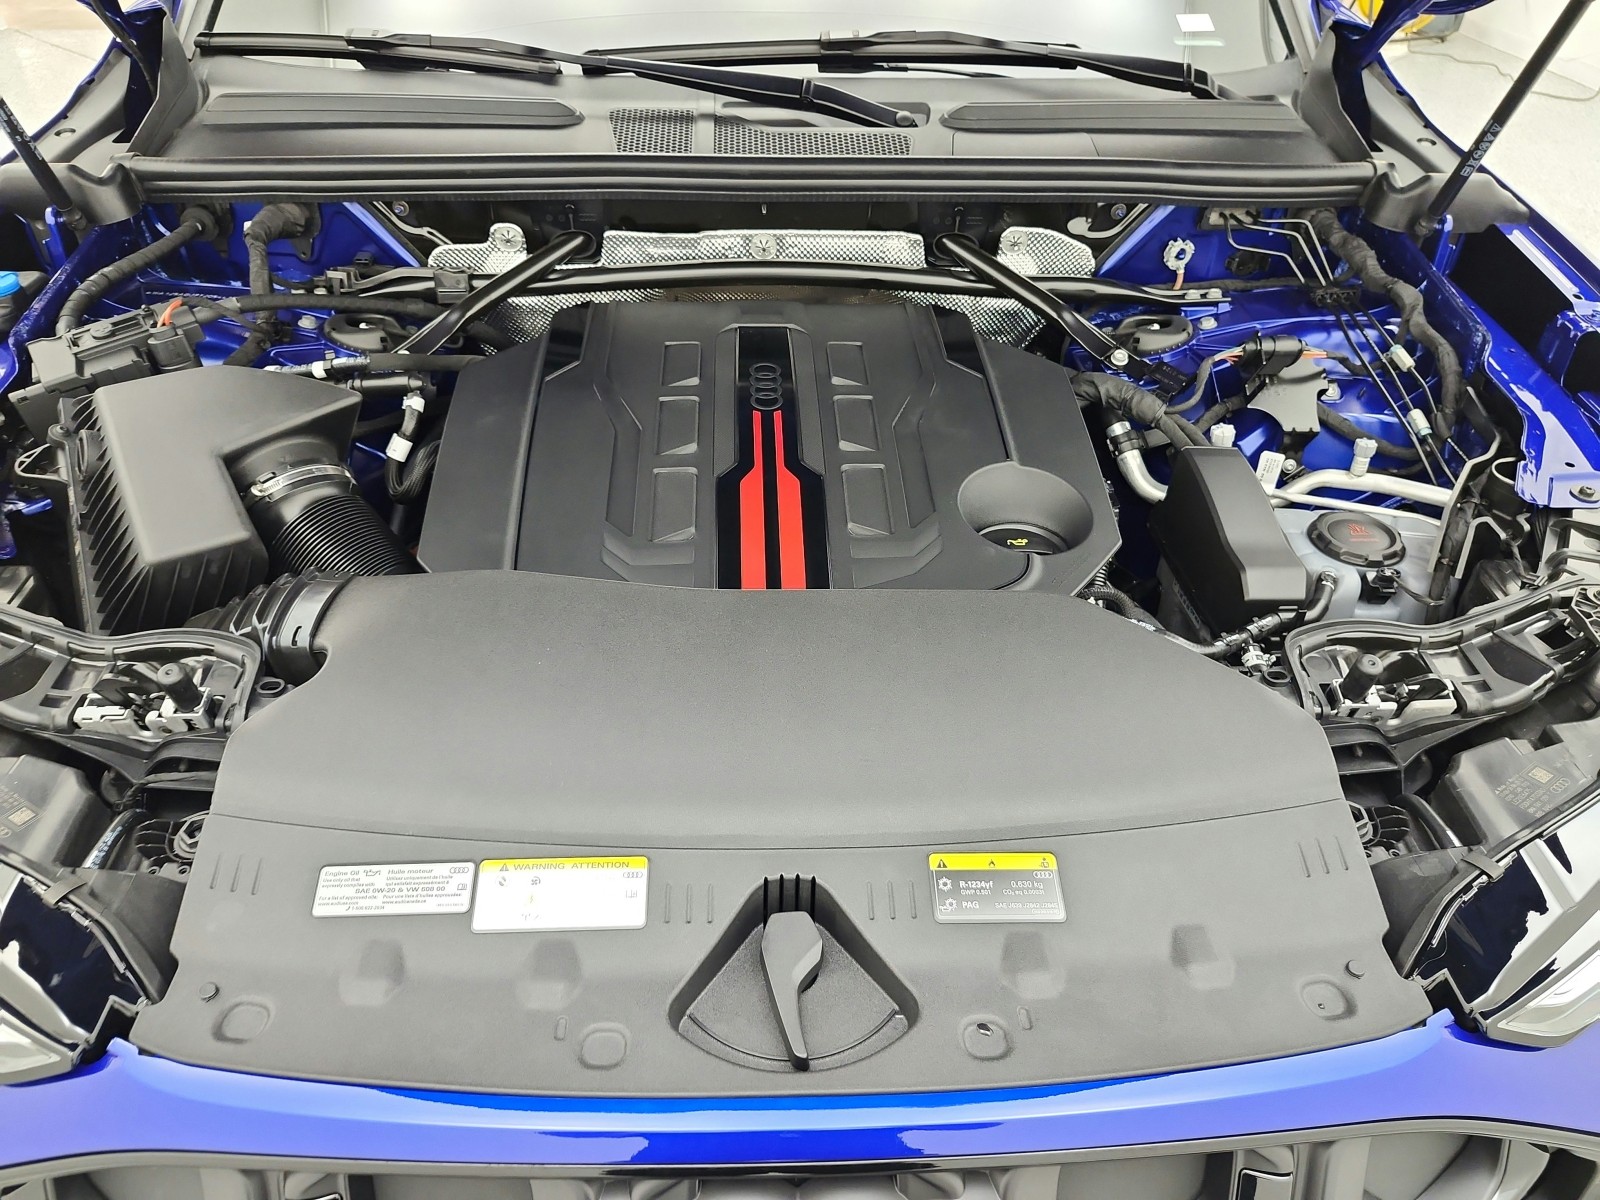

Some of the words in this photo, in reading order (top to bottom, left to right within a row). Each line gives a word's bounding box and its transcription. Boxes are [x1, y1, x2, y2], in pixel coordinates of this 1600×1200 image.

[514, 862, 565, 870] WARNING
[960, 881, 994, 889] R-1234yf
[1034, 881, 1043, 890] kg
